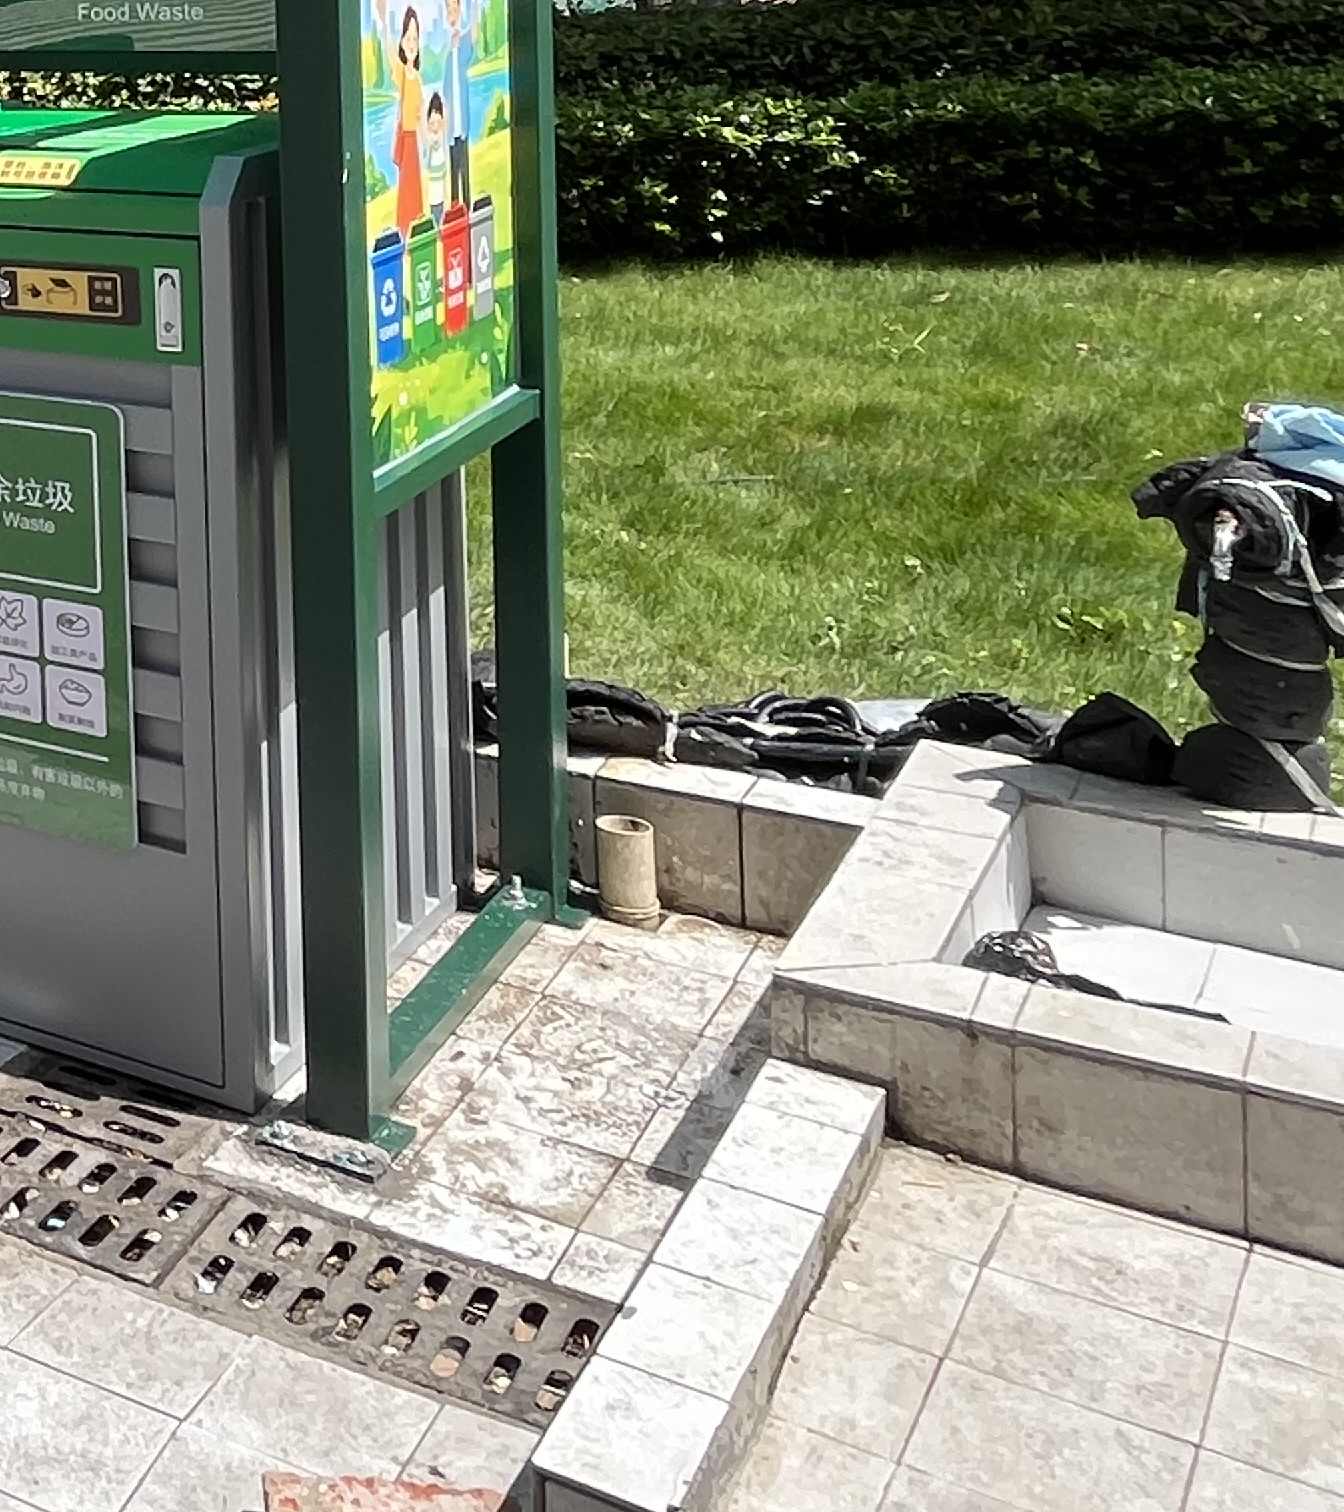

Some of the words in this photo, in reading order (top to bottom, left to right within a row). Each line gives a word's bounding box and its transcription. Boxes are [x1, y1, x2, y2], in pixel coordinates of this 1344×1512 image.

[77, 1, 130, 22] Food
[138, 1, 205, 22] Waste
[2, 510, 56, 534] Waste
